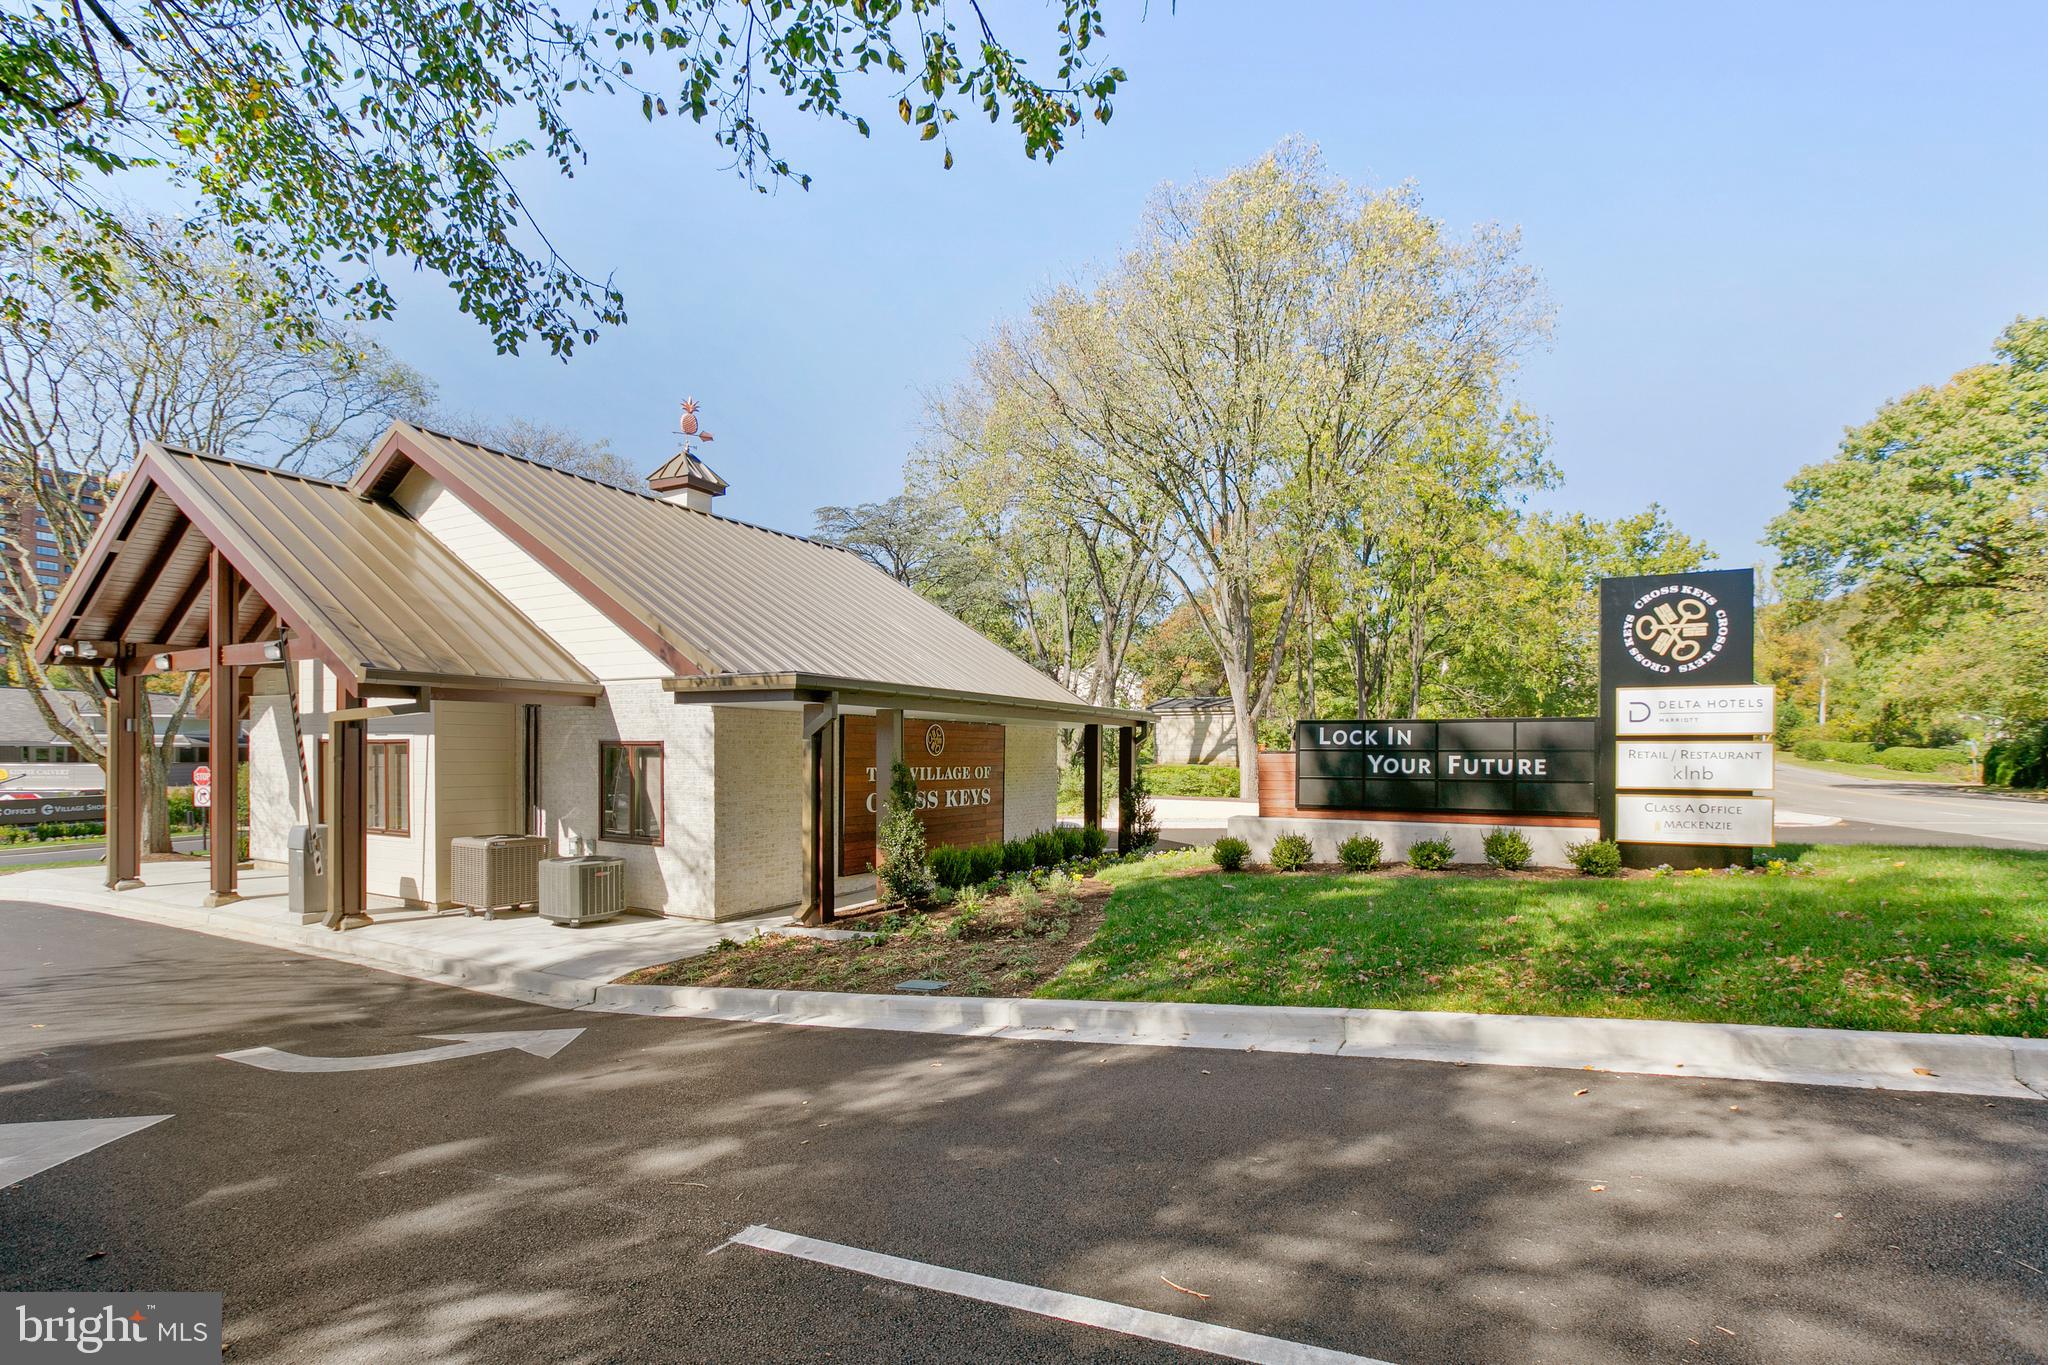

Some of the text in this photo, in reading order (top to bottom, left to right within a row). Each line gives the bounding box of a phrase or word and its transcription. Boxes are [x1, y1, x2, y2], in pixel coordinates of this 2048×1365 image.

[1634, 585, 1718, 610] CROSS KEYS
[1623, 614, 1671, 674] CROSS KEYS
[1678, 609, 1729, 673] CROSS KEYS
[1658, 698, 1764, 710] DELTA HOTELS
[1319, 726, 1412, 745] LOCK IN
[1628, 749, 1668, 760] RETAIL
[1680, 750, 1762, 760] RESTAURANT
[1368, 754, 1547, 776] YOUR FUTURE
[194, 772, 210, 780] STOP
[910, 766, 992, 781] VILLAGE OF
[1673, 765, 1714, 781] klnb
[54, 803, 105, 813] VILLAGE SHOP
[866, 788, 991, 813] CSS KEYS
[3, 807, 37, 816] OFFICES
[1644, 803, 1742, 815] CLASS A OFFICE
[1664, 821, 1733, 830] MACKENZIE
